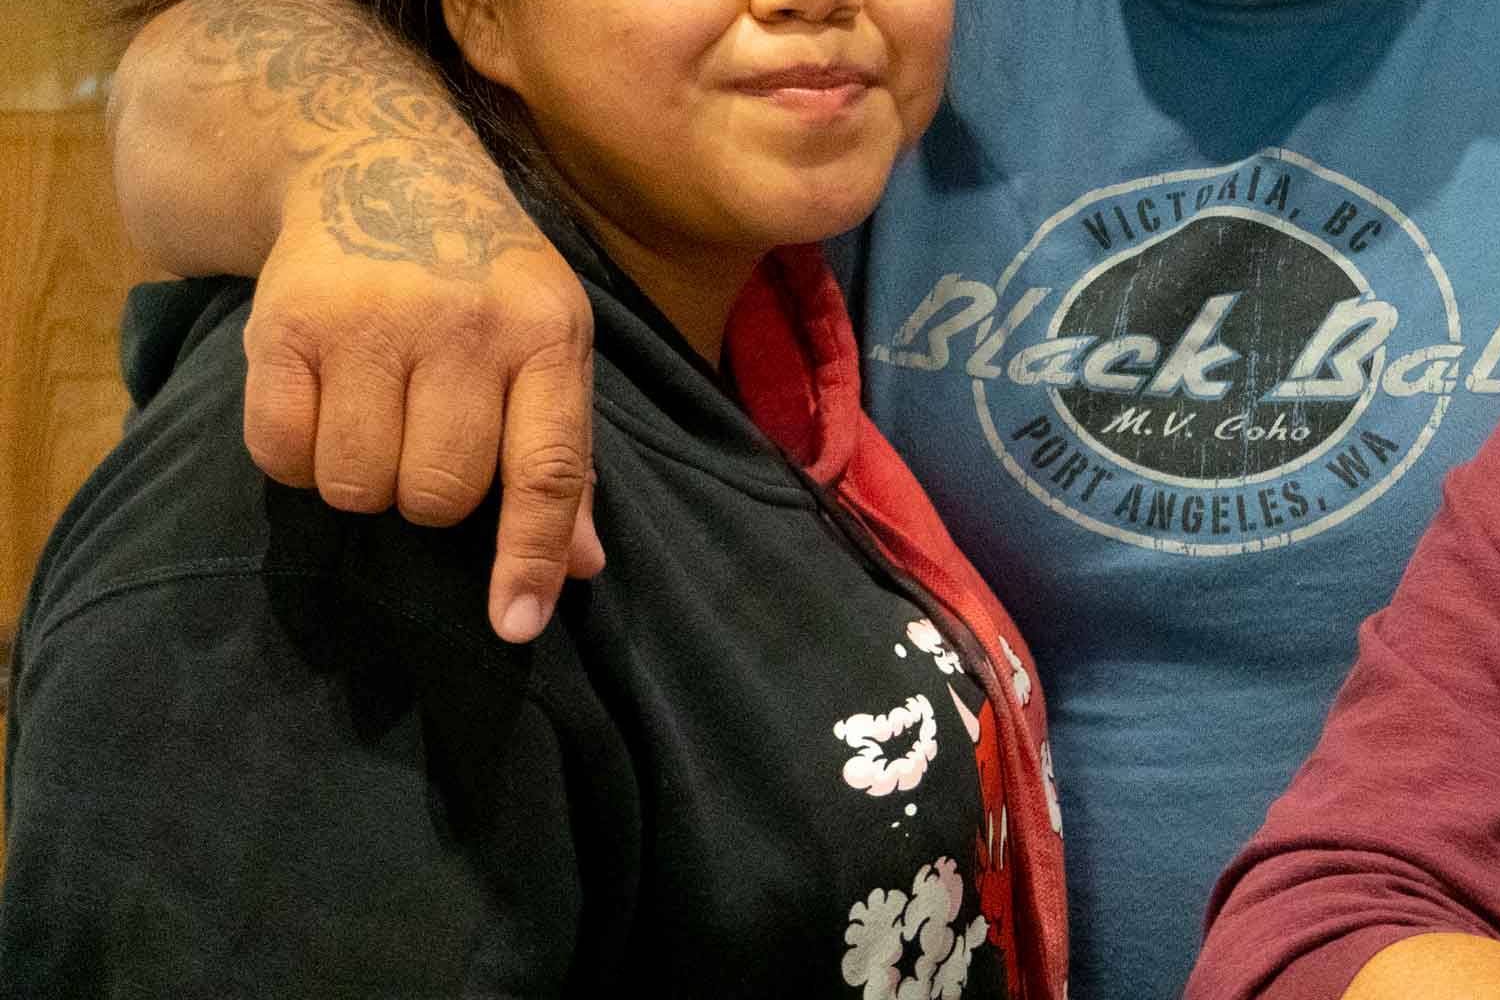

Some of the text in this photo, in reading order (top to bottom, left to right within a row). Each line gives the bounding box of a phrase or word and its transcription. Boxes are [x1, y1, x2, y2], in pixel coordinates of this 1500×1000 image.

[1321, 198, 1383, 253] BC
[868, 272, 1241, 398] Black
[1213, 411, 1312, 443] Coho
[1010, 415, 1401, 536] PORT ANGELES, WA
